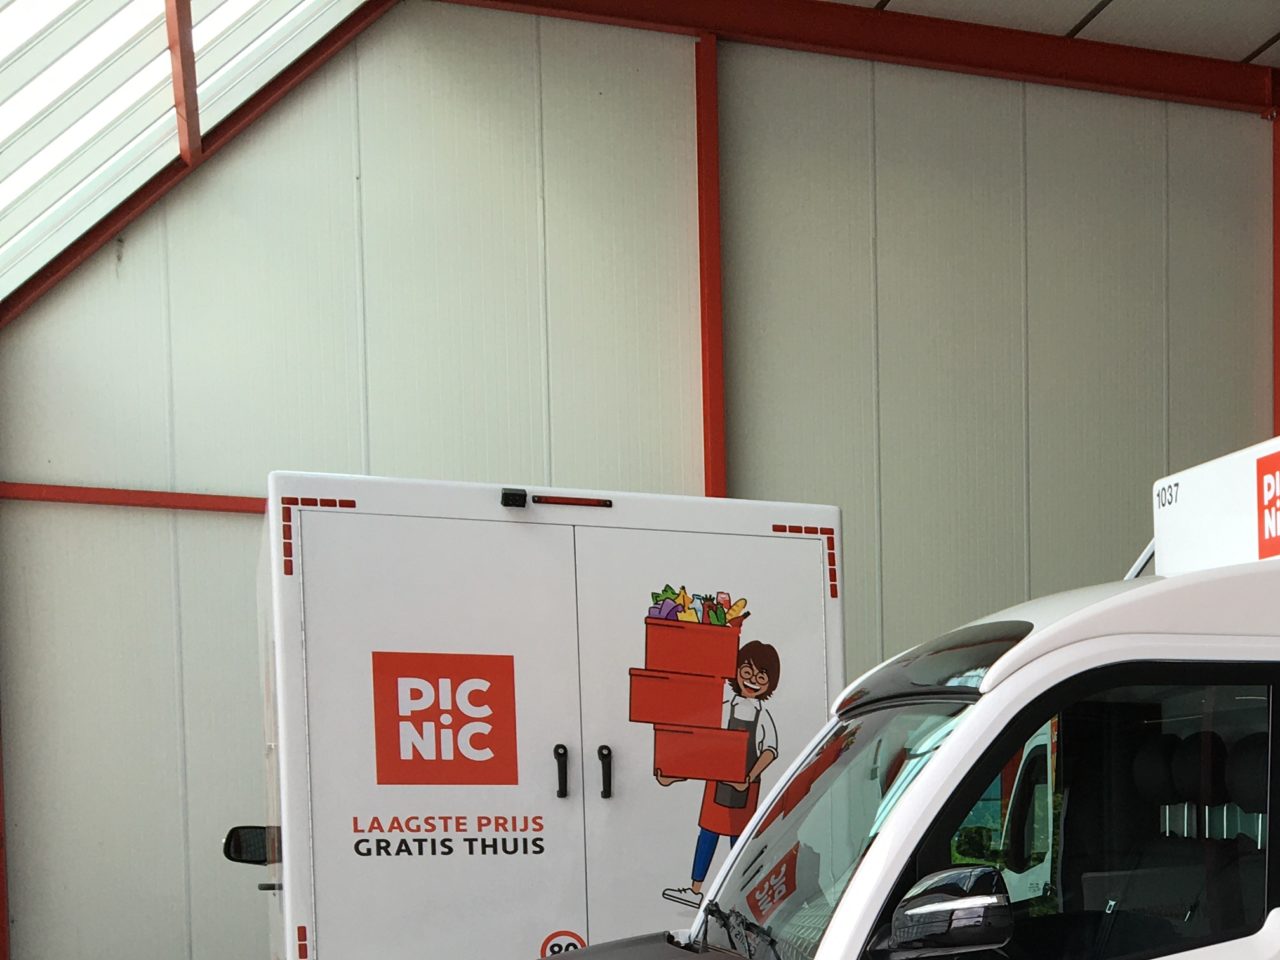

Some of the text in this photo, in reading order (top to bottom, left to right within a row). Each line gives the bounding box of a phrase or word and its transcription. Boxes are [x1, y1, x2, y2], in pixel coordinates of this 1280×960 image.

[1156, 482, 1180, 509] 1037
[396, 676, 494, 719] PIC
[352, 815, 544, 833] LAAGSTE PRIJS
[353, 837, 545, 857] GRATIS THUIS
